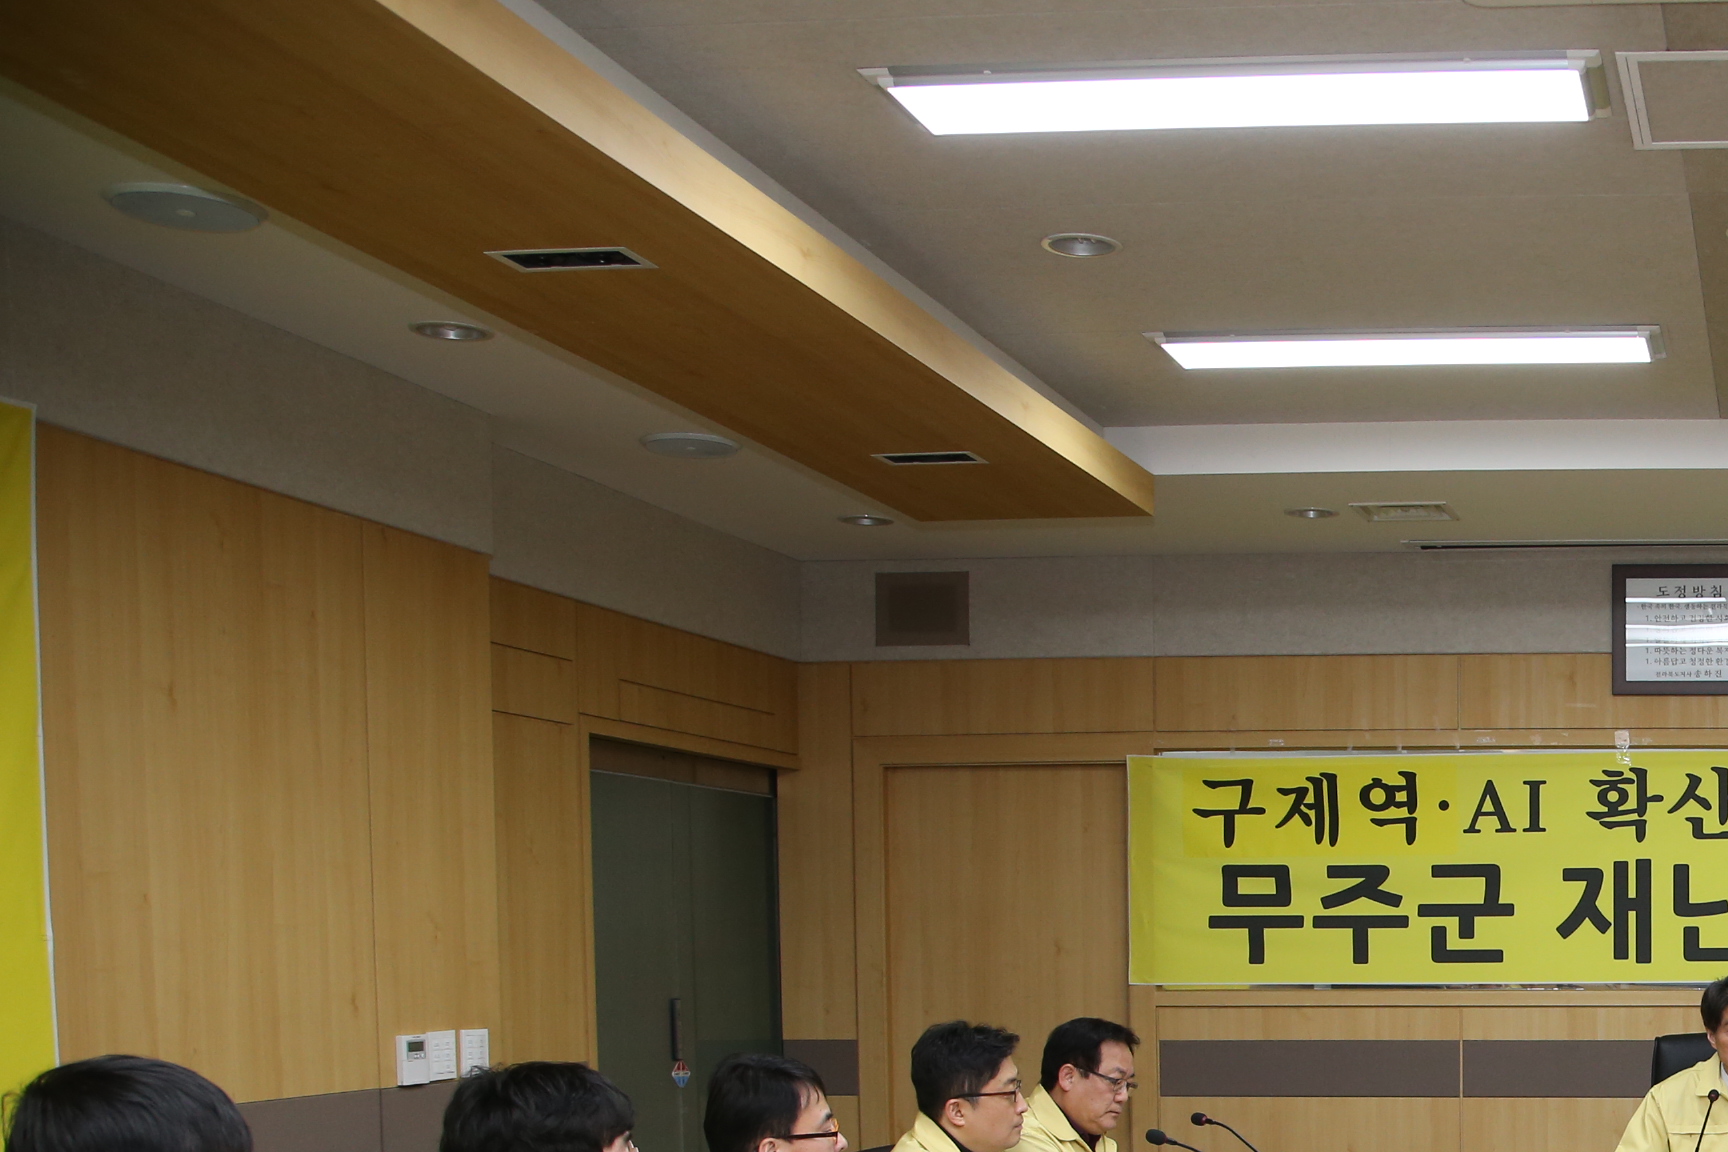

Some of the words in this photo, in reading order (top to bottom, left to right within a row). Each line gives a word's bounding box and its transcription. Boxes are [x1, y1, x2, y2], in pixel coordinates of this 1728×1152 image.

[1656, 585, 1723, 598] 도정방침
[1654, 614, 1686, 622] 안전하고
[1654, 658, 1686, 666] 아름답고
[1208, 863, 1515, 965] 무주군
